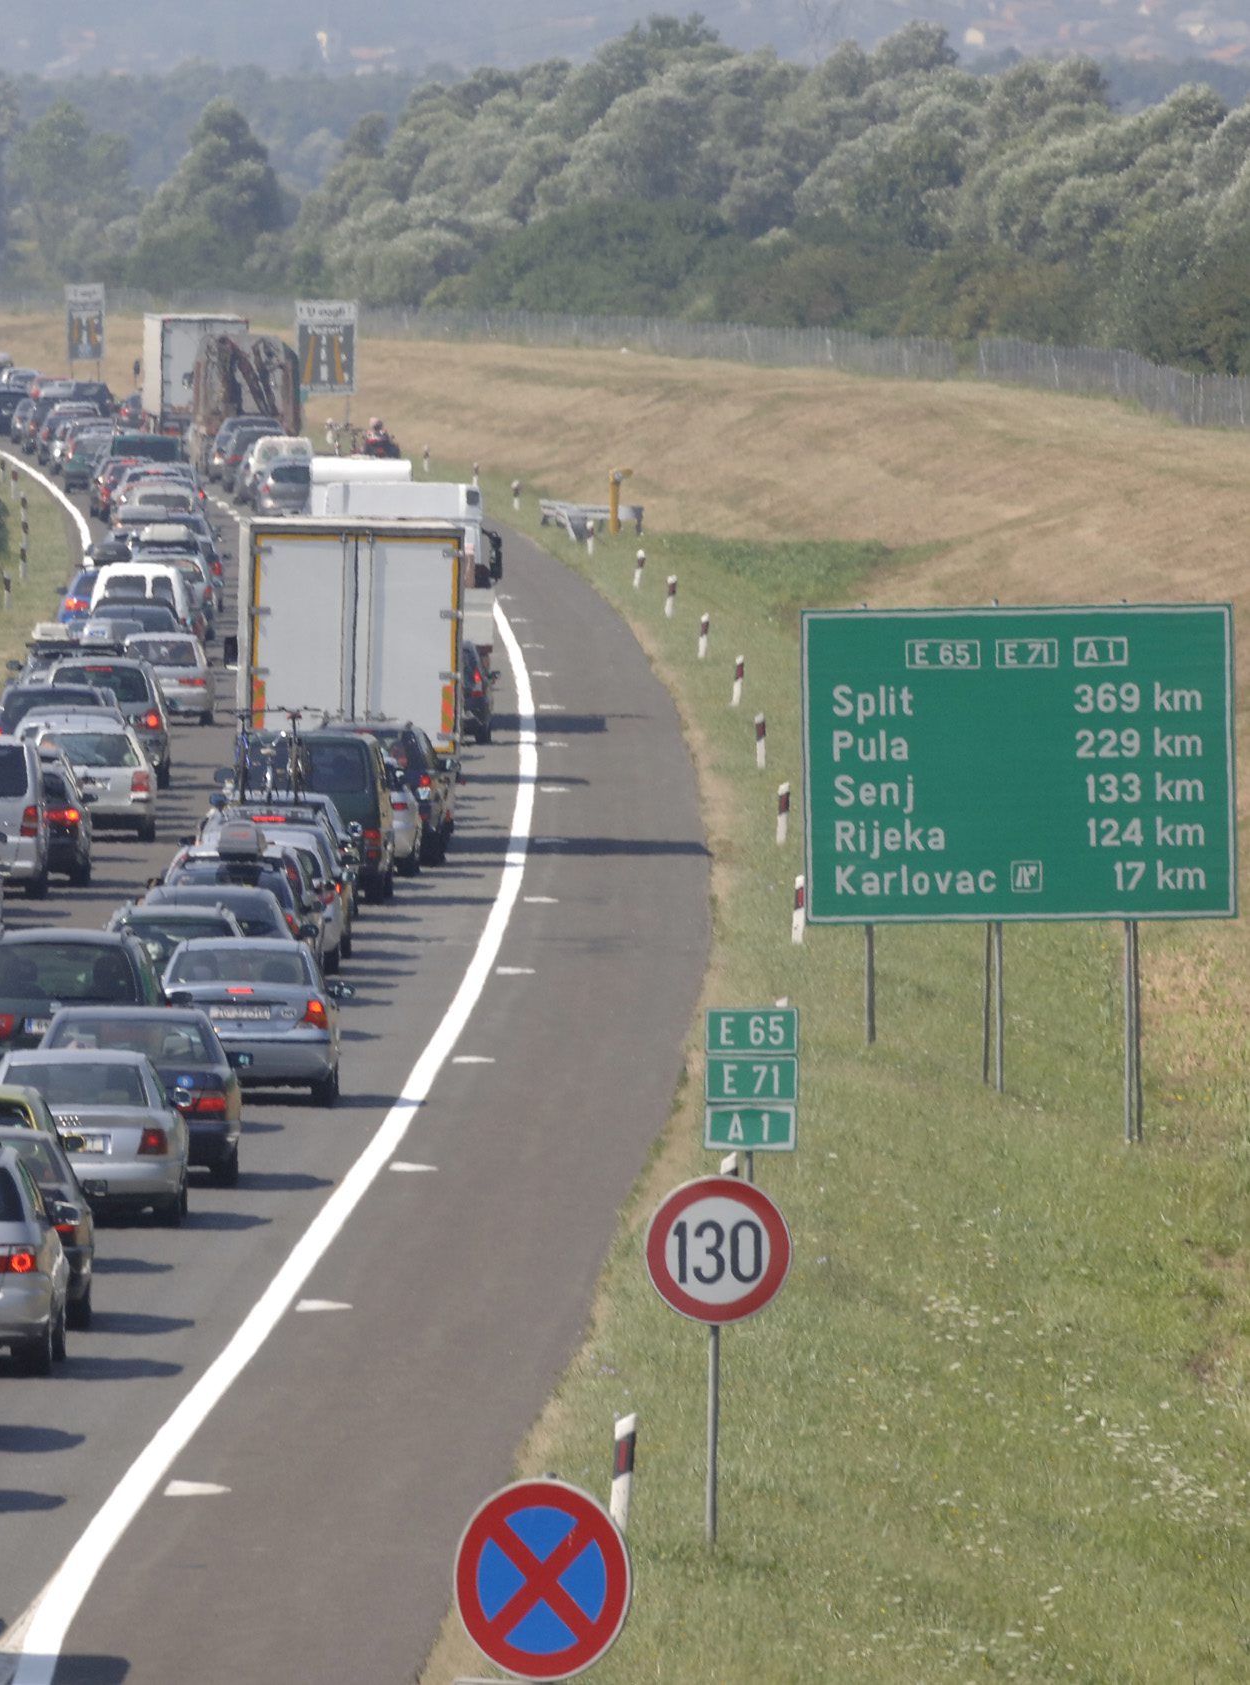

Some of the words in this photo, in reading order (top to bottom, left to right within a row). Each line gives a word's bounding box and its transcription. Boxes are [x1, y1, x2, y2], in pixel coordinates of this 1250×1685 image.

[915, 645, 929, 664] E
[939, 644, 970, 664] 65
[1005, 644, 1017, 664] E
[1027, 643, 1049, 664] 71
[1083, 643, 1099, 661] A
[1107, 642, 1115, 661] 1
[833, 685, 913, 724] Split
[1074, 683, 1140, 713] 369
[1155, 682, 1202, 711] km
[833, 730, 908, 762] Pula
[1076, 728, 1140, 758] 229
[1154, 727, 1202, 756] km
[835, 775, 913, 814] Senj
[1086, 773, 1141, 803] 133
[1155, 772, 1204, 801] km
[835, 819, 945, 859] Rijeka
[1087, 818, 1143, 847] 124
[1156, 816, 1204, 846] km
[835, 864, 996, 895] Karlovac
[1114, 862, 1145, 890] 17
[1157, 860, 1206, 889] km
[720, 1017, 734, 1045] E
[749, 1016, 785, 1045] 65
[723, 1064, 737, 1094] E
[753, 1065, 779, 1095] 71
[727, 1112, 744, 1141] A
[760, 1112, 770, 1142] 1
[673, 1219, 763, 1285] 130
